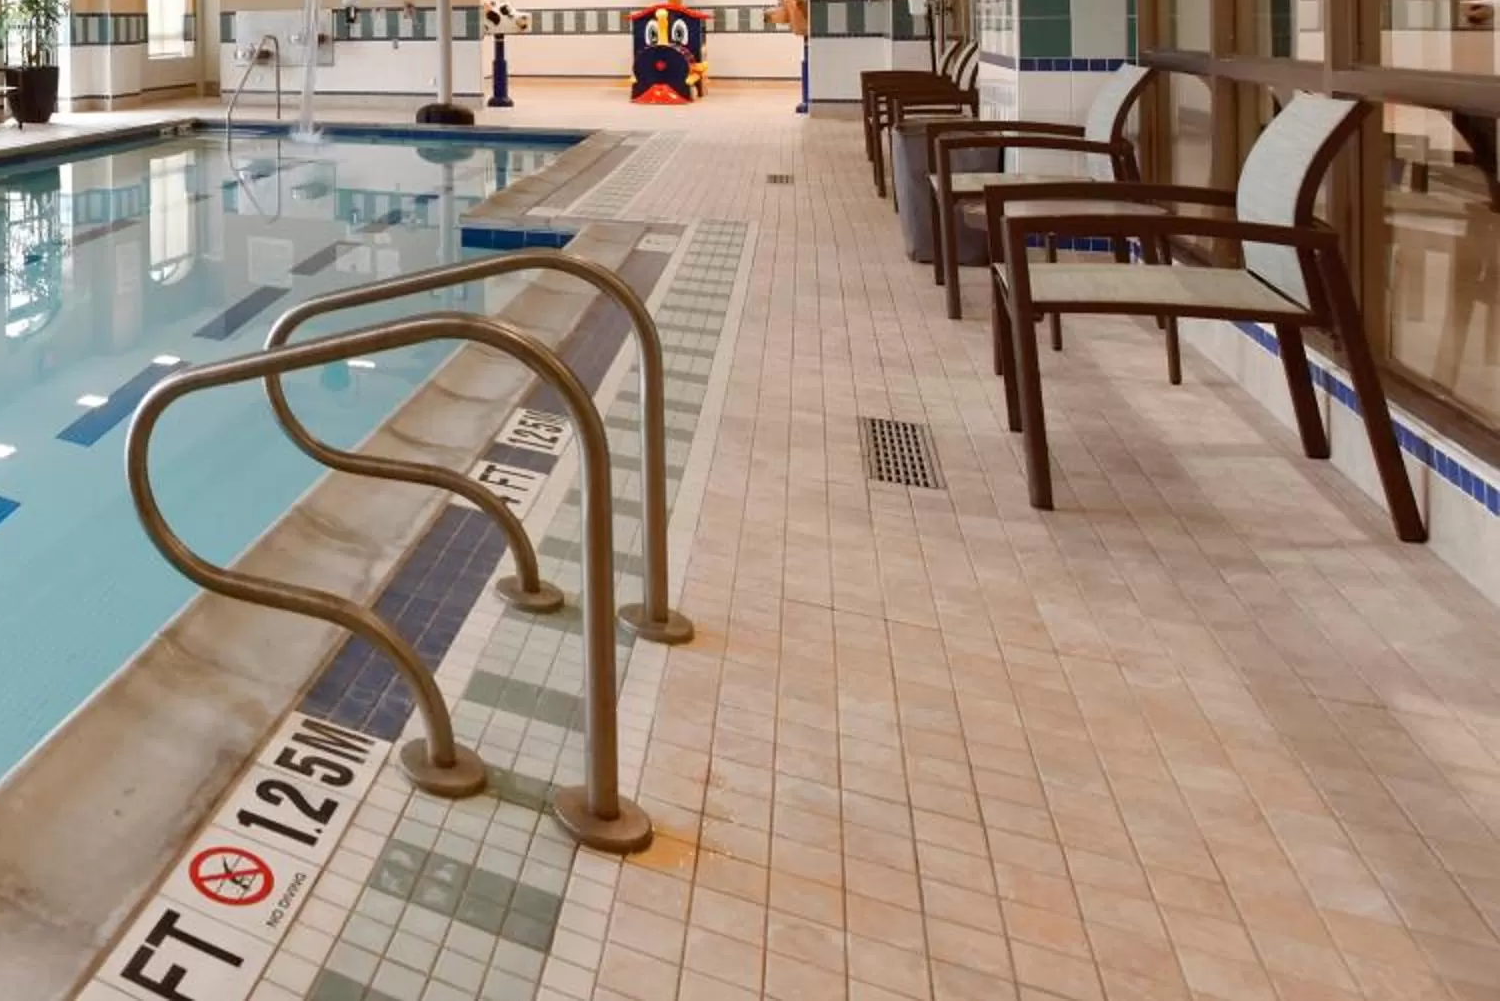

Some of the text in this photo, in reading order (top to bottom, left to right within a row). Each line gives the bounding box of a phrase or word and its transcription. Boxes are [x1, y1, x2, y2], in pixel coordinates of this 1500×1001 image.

[479, 464, 537, 491] FT
[266, 908, 285, 928] NO
[120, 908, 244, 1001] FT
